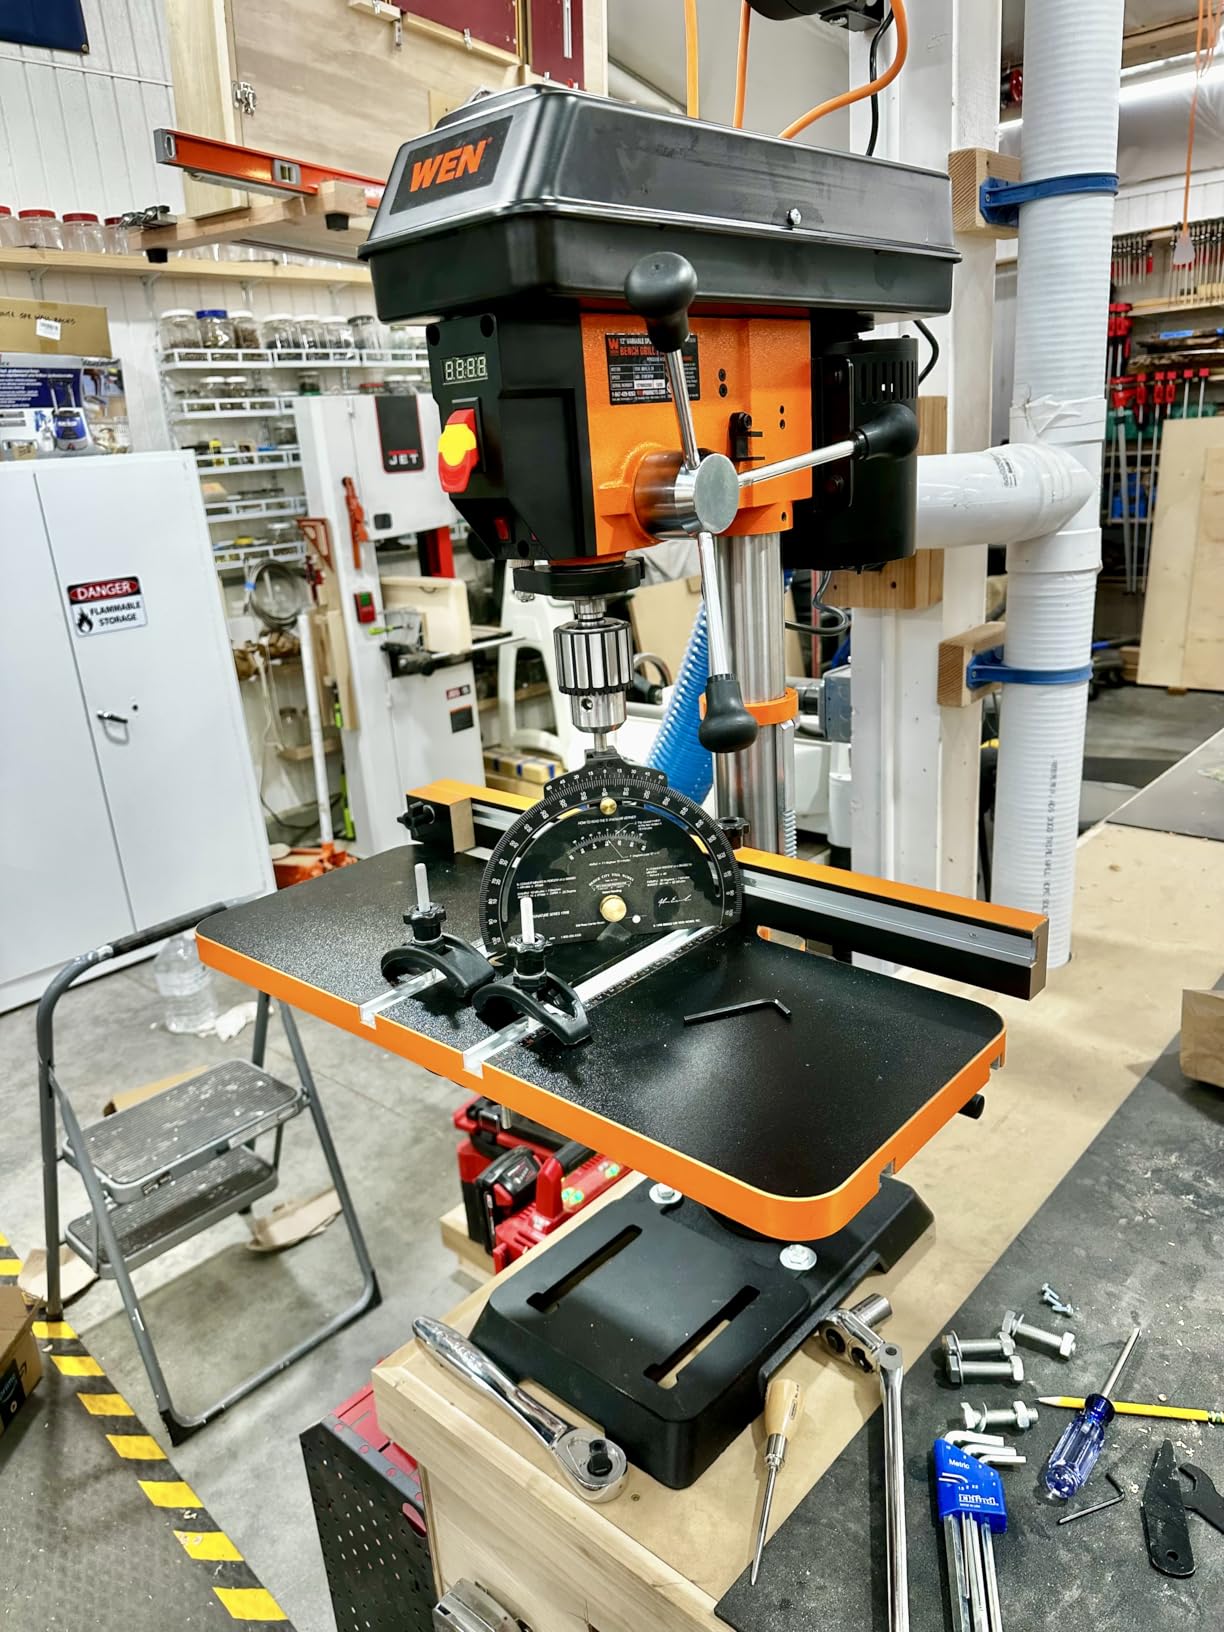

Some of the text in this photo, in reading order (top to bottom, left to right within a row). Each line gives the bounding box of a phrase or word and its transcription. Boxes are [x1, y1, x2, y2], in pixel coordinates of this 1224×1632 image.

[410, 140, 487, 192] WEN
[620, 346, 638, 356] BENCH
[640, 345, 655, 355] DRILL
[388, 454, 418, 465] JET
[76, 581, 132, 600] DANGER
[90, 601, 141, 616] FLAMMABLE
[98, 613, 136, 626] STORAGE
[949, 1458, 970, 1469] Metric
